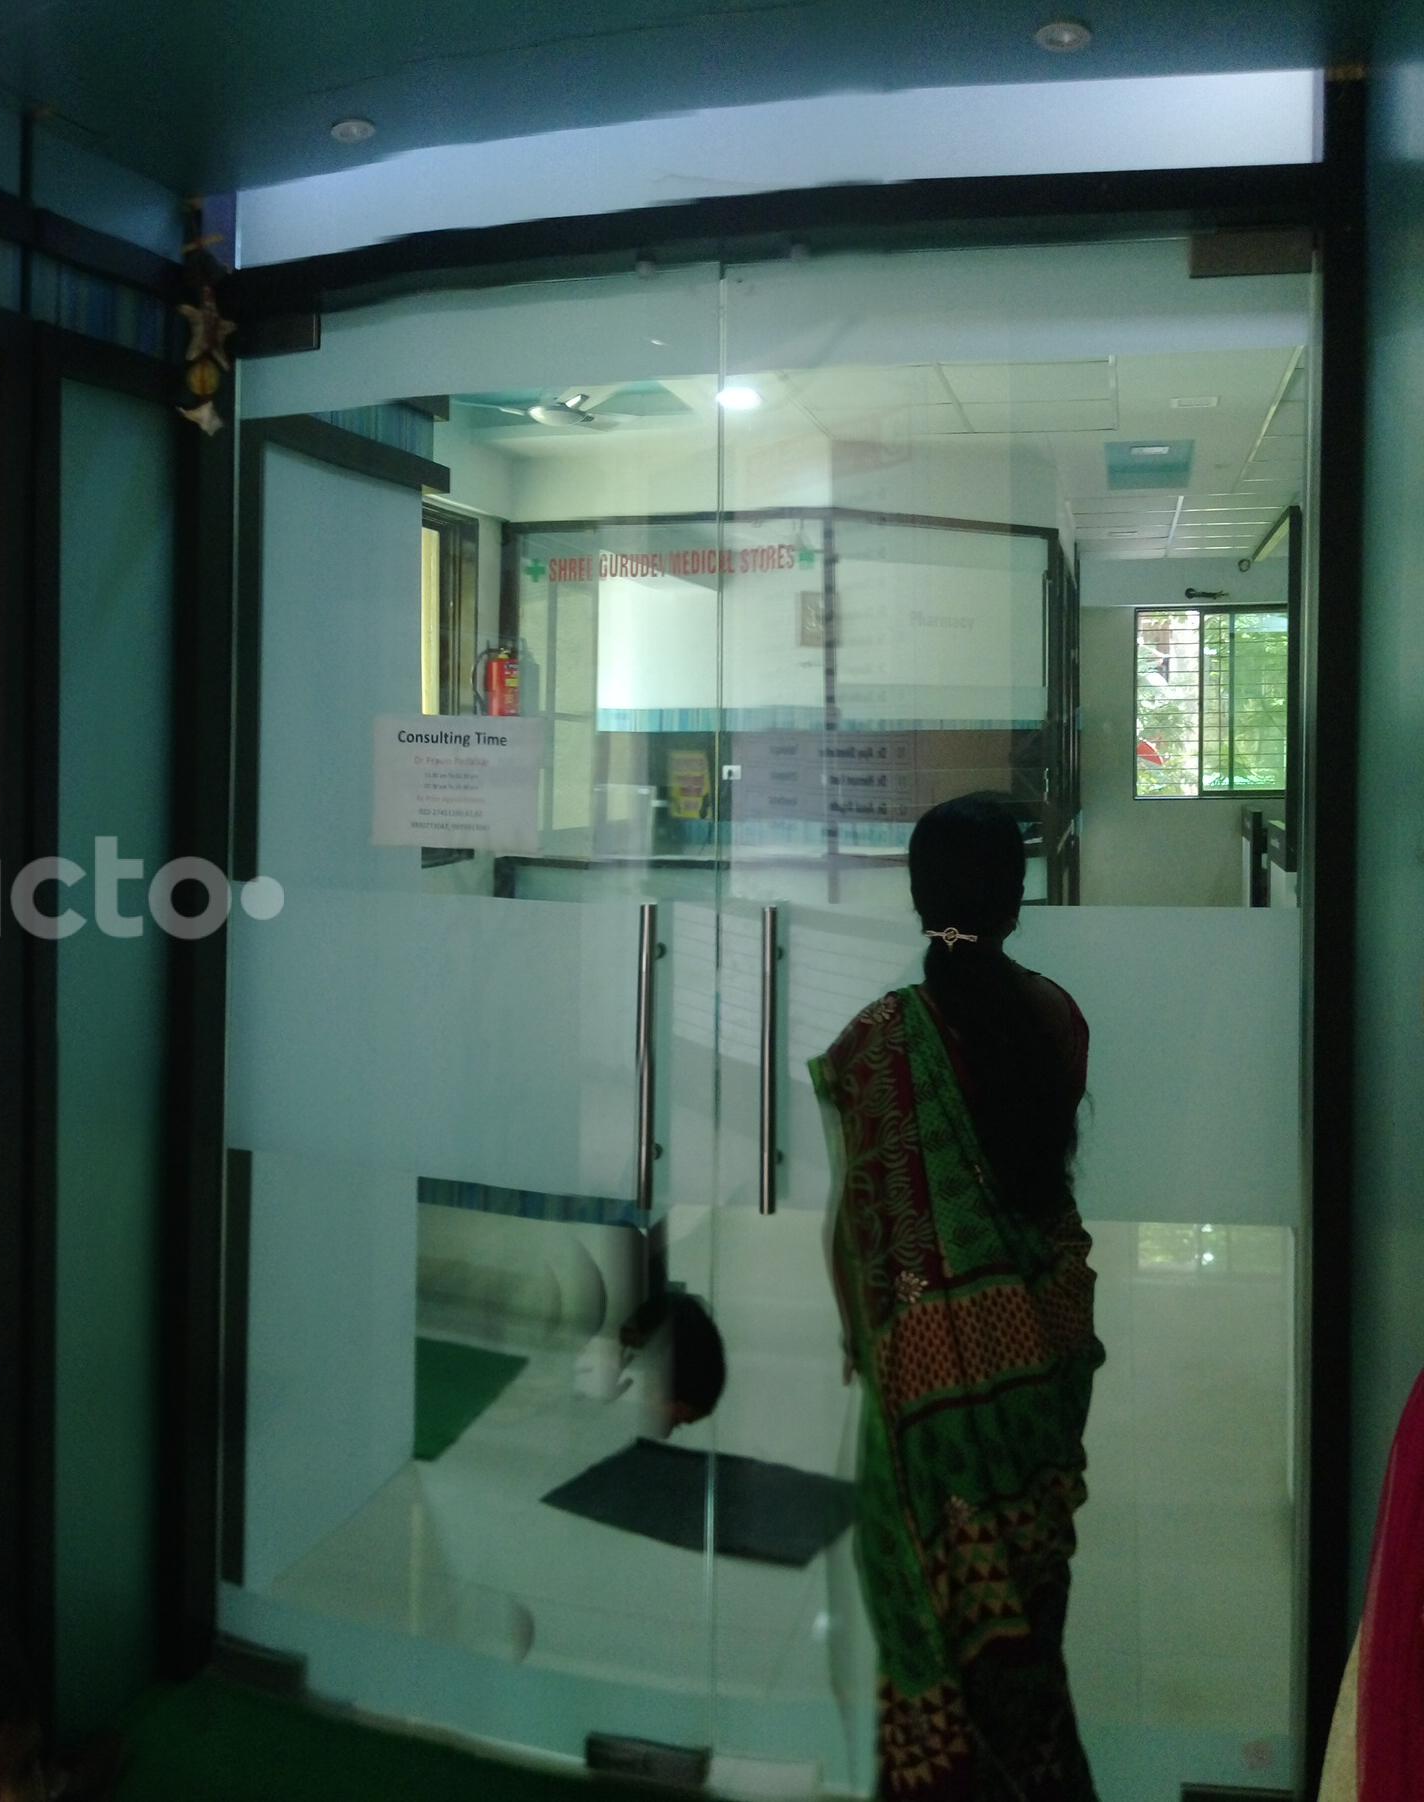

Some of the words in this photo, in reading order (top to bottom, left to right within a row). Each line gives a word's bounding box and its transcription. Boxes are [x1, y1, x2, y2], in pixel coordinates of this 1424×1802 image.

[740, 544, 795, 573] STORES
[397, 730, 471, 747] Consulting
[475, 731, 508, 747] Time
